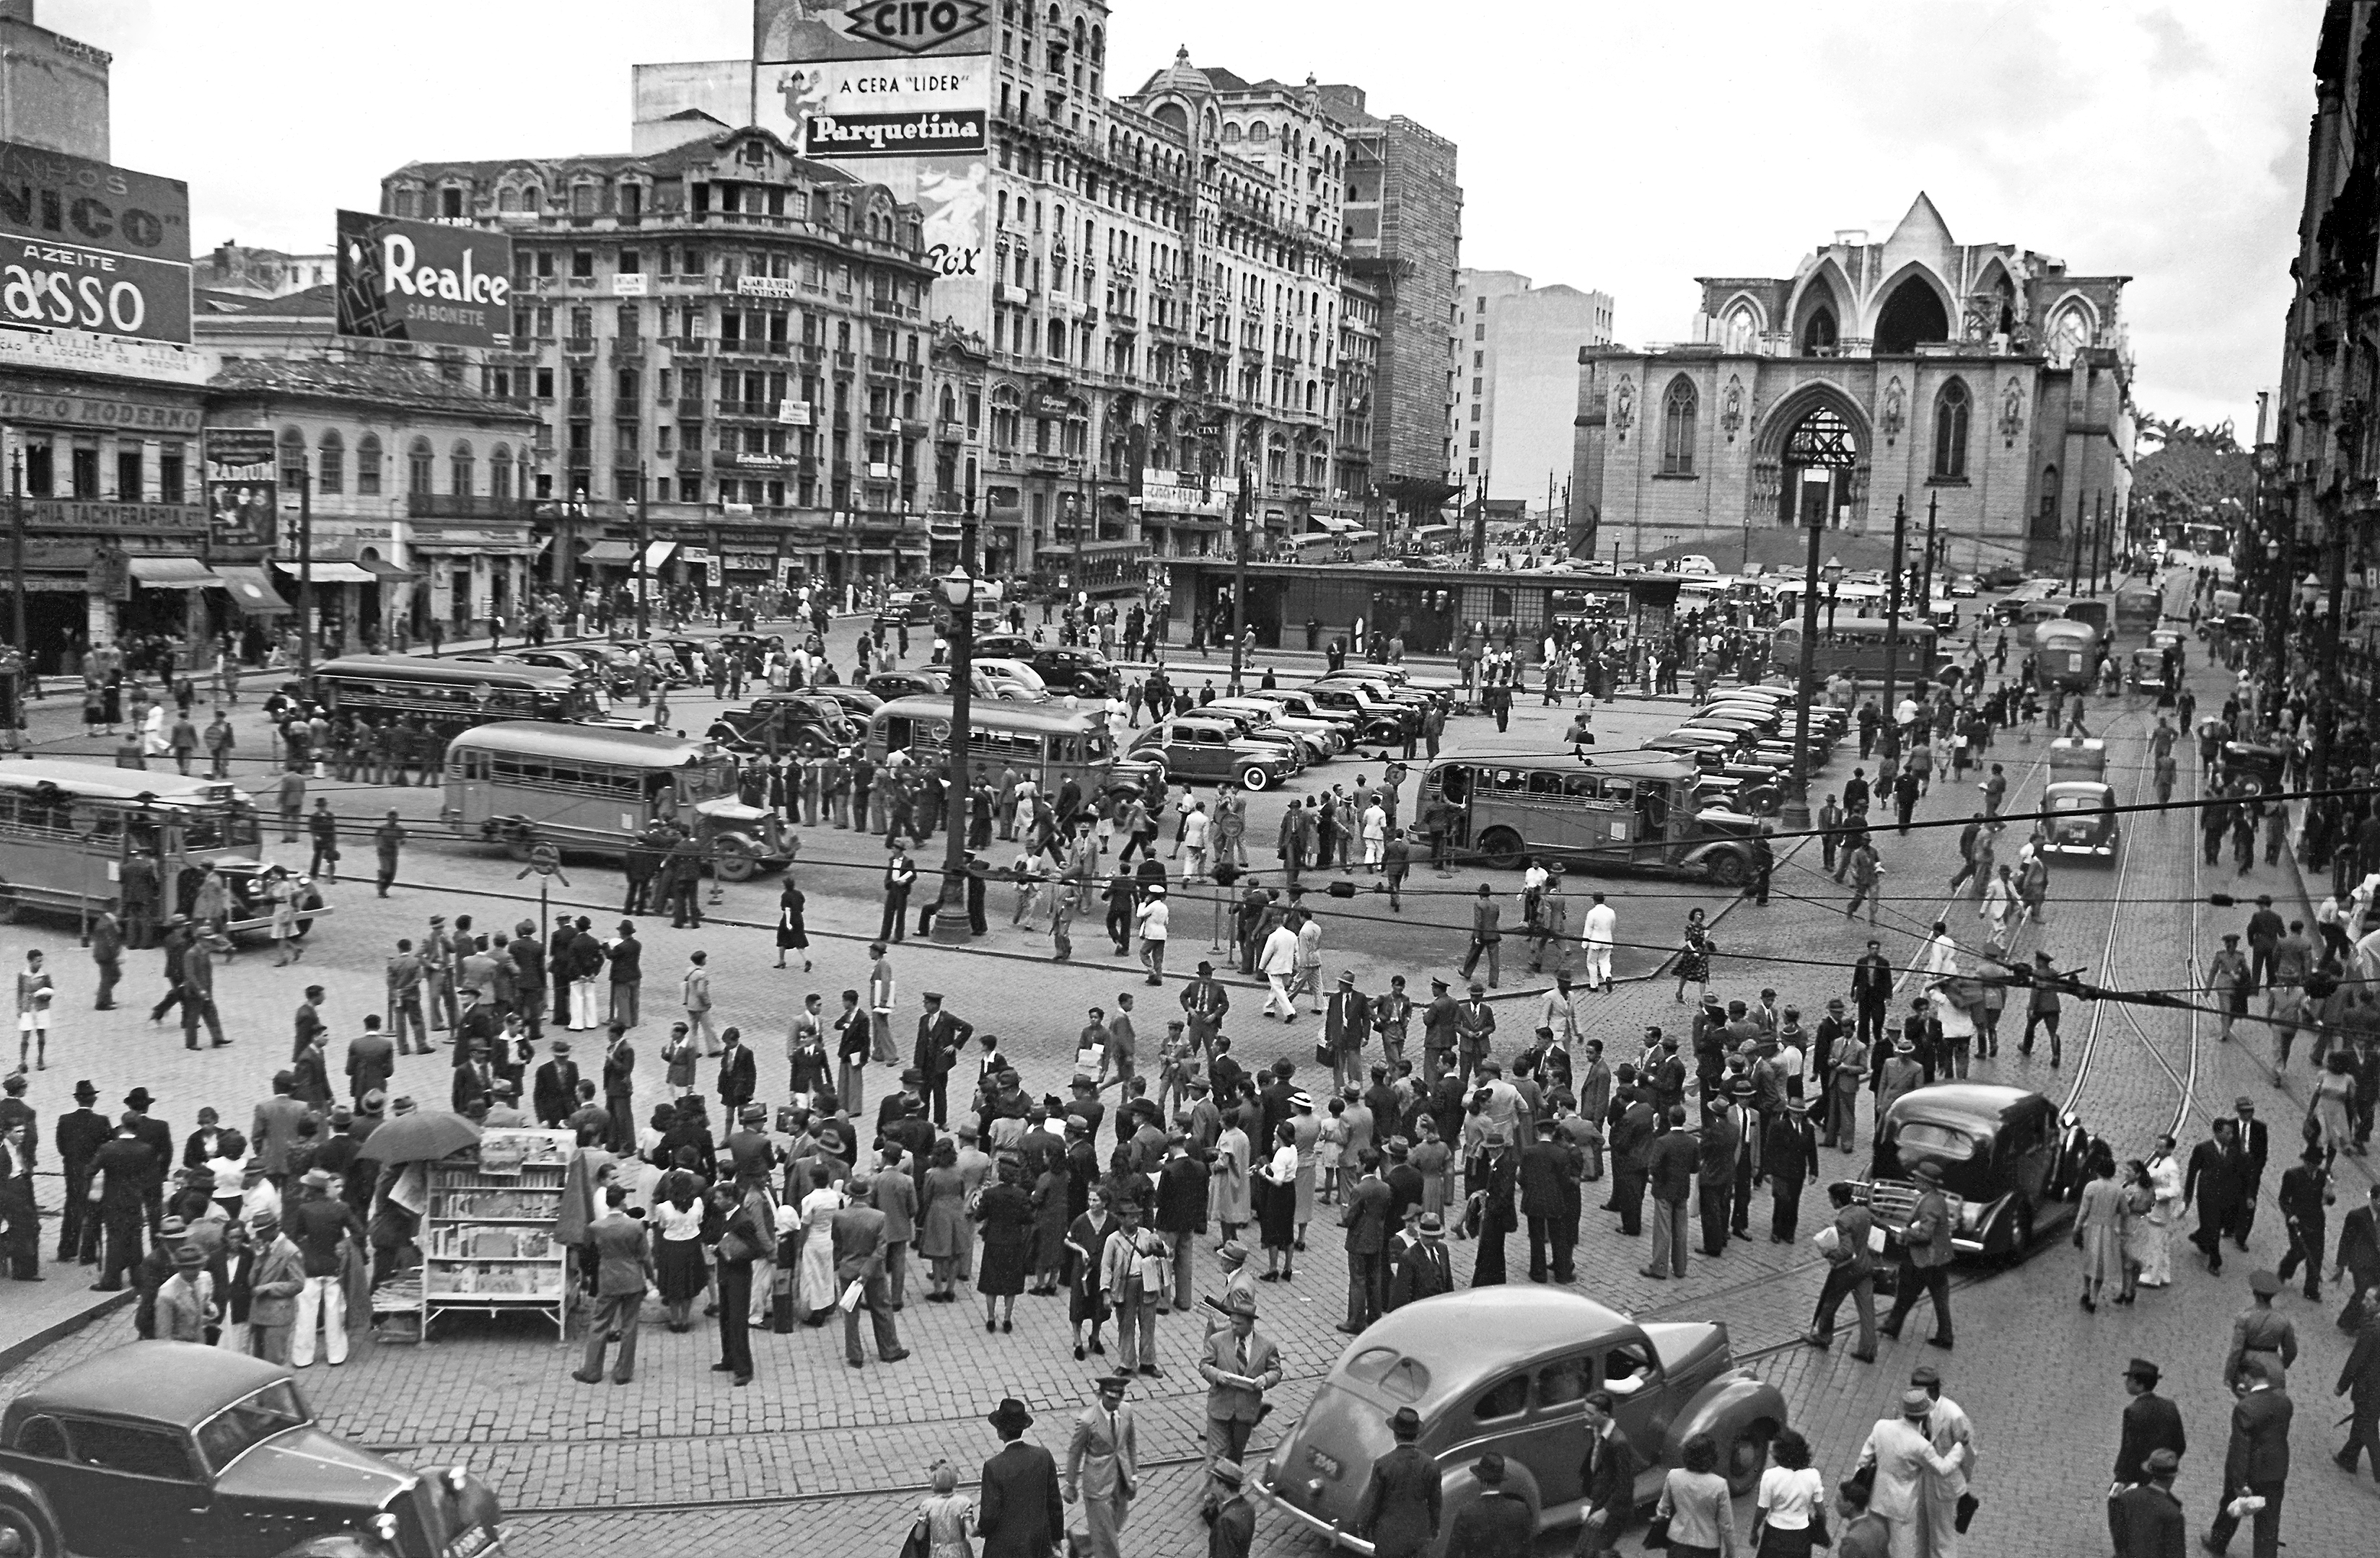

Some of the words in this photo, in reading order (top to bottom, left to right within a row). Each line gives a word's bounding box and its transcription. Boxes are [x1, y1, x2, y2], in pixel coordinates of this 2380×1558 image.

[873, 1, 960, 36] CITO
[840, 79, 852, 94] A
[858, 77, 900, 94] CERA
[813, 113, 980, 149] Parquetina
[23, 245, 117, 273] AZEITE
[383, 233, 509, 307] Realce
[741, 287, 790, 298] DENTISTA
[406, 303, 486, 325] SABONETE
[29, 333, 125, 354] PAULISTA
[81, 400, 198, 427] MODERNO
[1196, 426, 1221, 434] CINE
